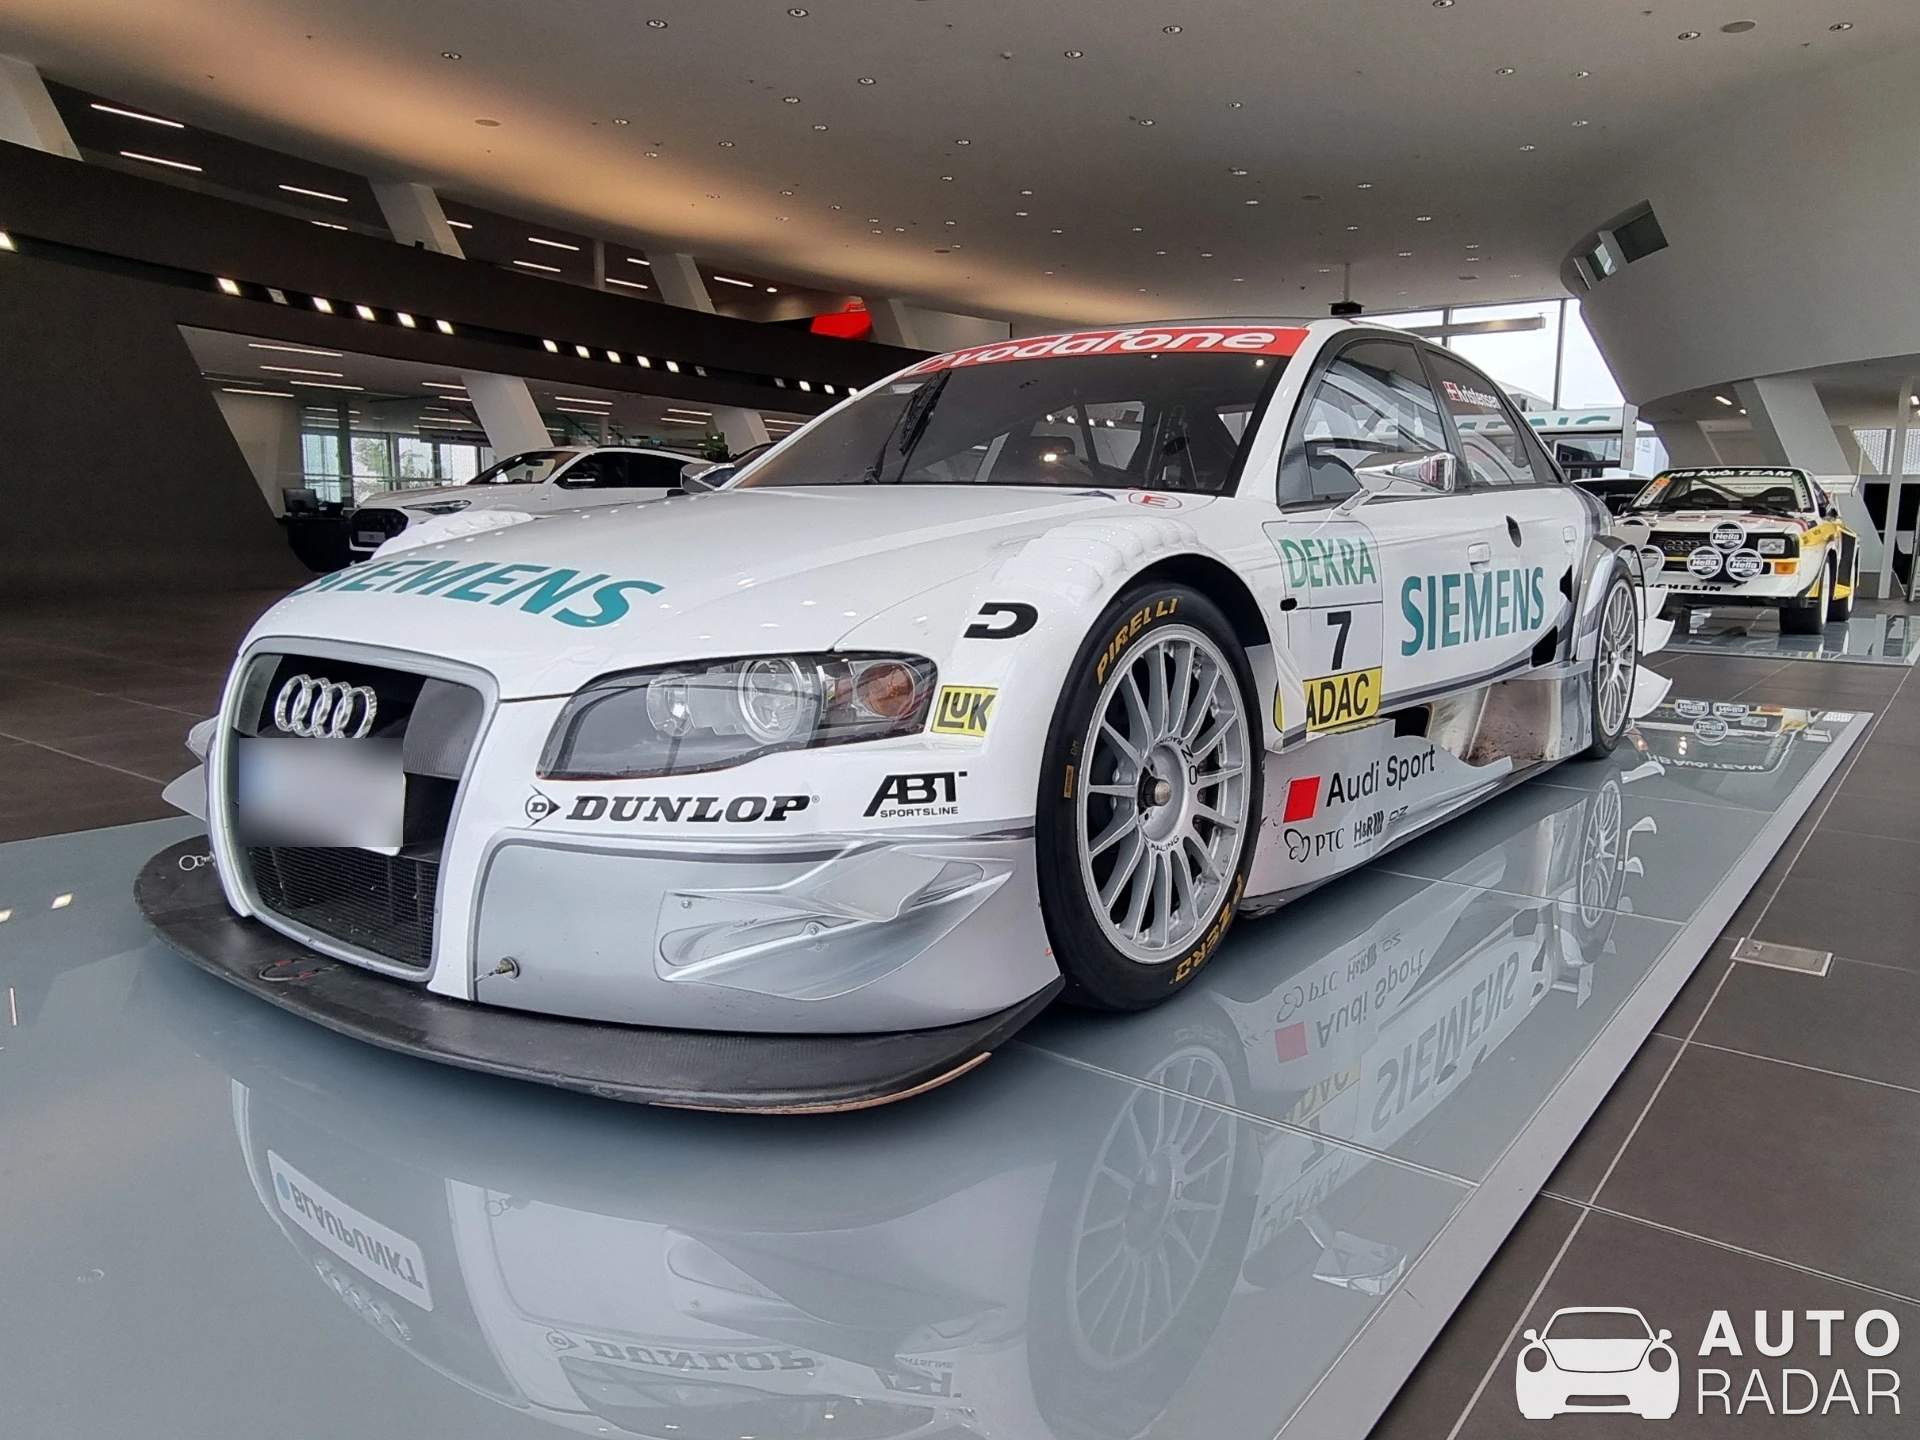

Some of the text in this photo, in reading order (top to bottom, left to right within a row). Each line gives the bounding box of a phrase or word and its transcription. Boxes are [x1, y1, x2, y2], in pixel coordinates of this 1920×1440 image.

[952, 330, 1275, 366] vodafone
[1668, 470, 1695, 478] HB
[1714, 532, 1740, 541] Hella
[1278, 537, 1378, 588] DEKRA
[1692, 559, 1717, 567] Hella
[1732, 562, 1758, 570] Hella
[287, 559, 665, 628] SIEMENS
[1401, 566, 1544, 657] SIEMENS
[1096, 598, 1178, 685] PIRELLI
[1327, 611, 1351, 671] 7
[1306, 674, 1370, 727] ADAC
[862, 771, 959, 817] ABT
[1326, 744, 1436, 807] Audi Sport
[566, 795, 812, 823] DUNLOP
[879, 806, 959, 818] SPORTSLINE
[1314, 828, 1345, 856] PTC
